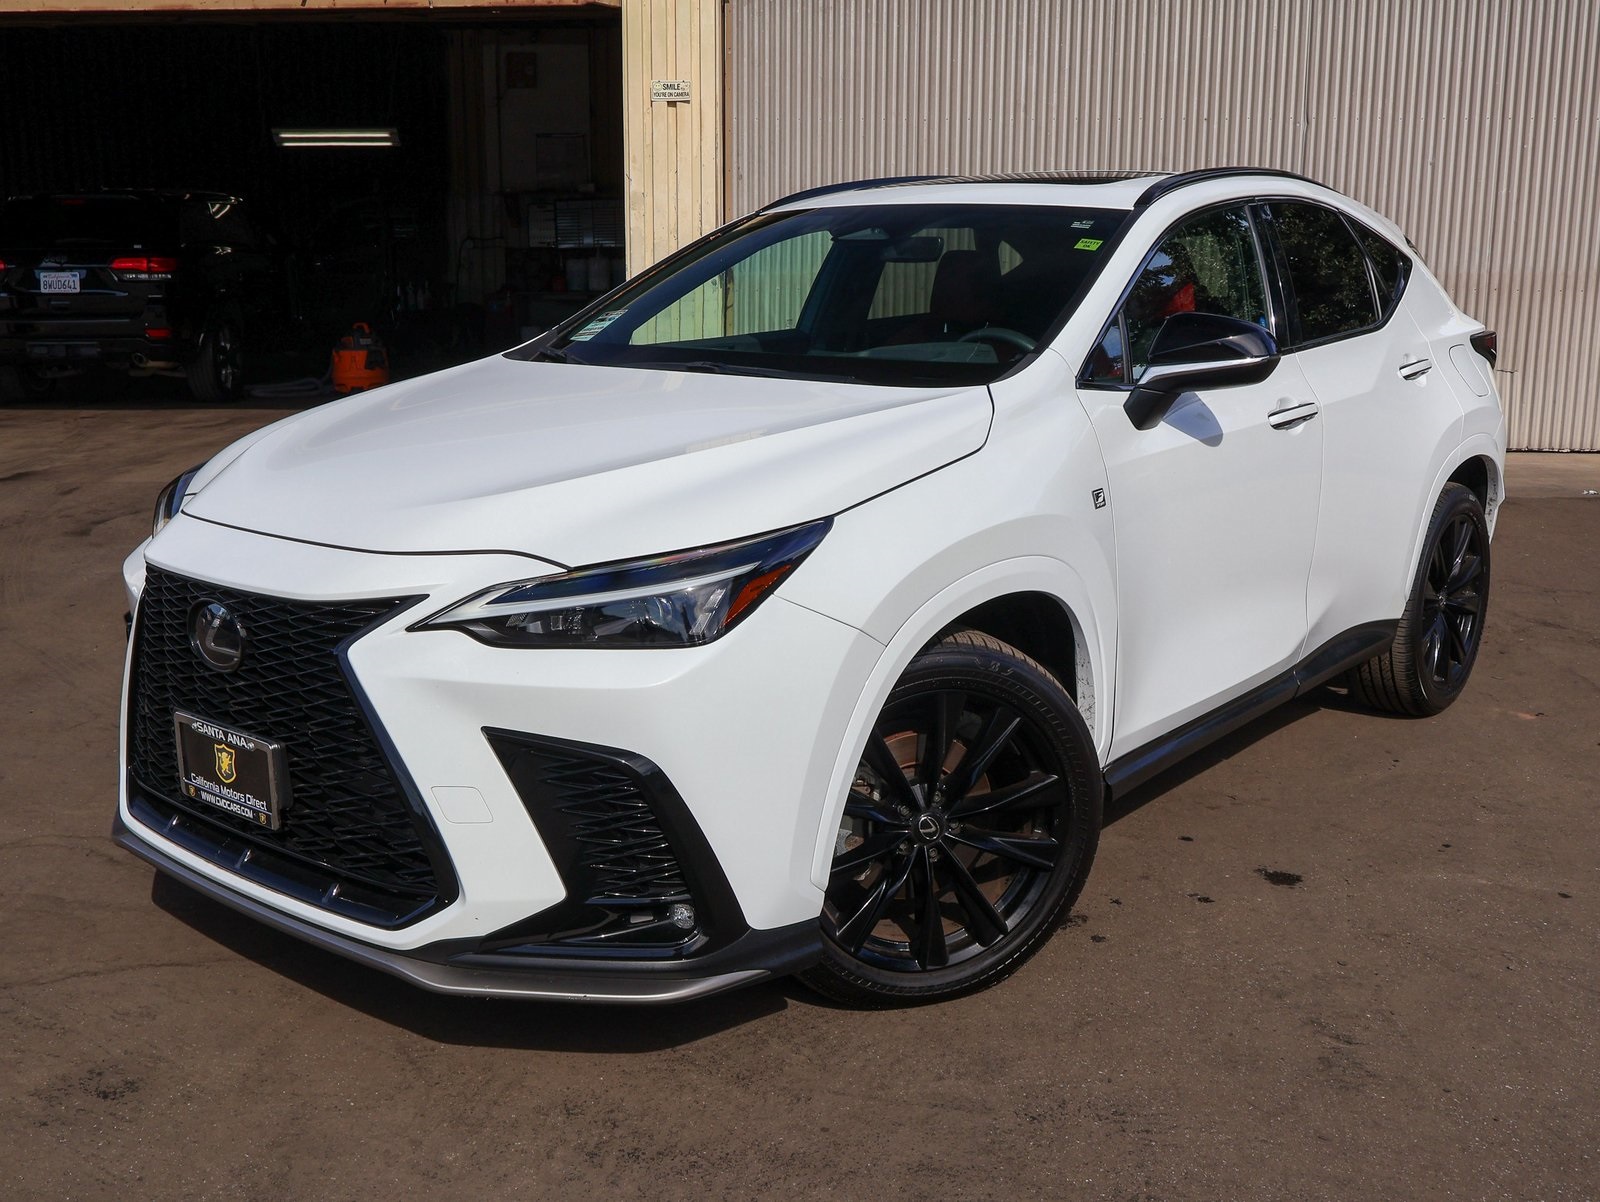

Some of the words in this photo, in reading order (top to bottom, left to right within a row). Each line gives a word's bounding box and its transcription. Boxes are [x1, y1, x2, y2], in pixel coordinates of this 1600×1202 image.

[662, 83, 681, 91] SMILE
[43, 279, 77, 290] 8WUD641
[197, 721, 226, 741] SANTA
[227, 733, 248, 749] ANA
[190, 773, 220, 793] California
[220, 784, 245, 802] Motors
[246, 793, 268, 811] Direct
